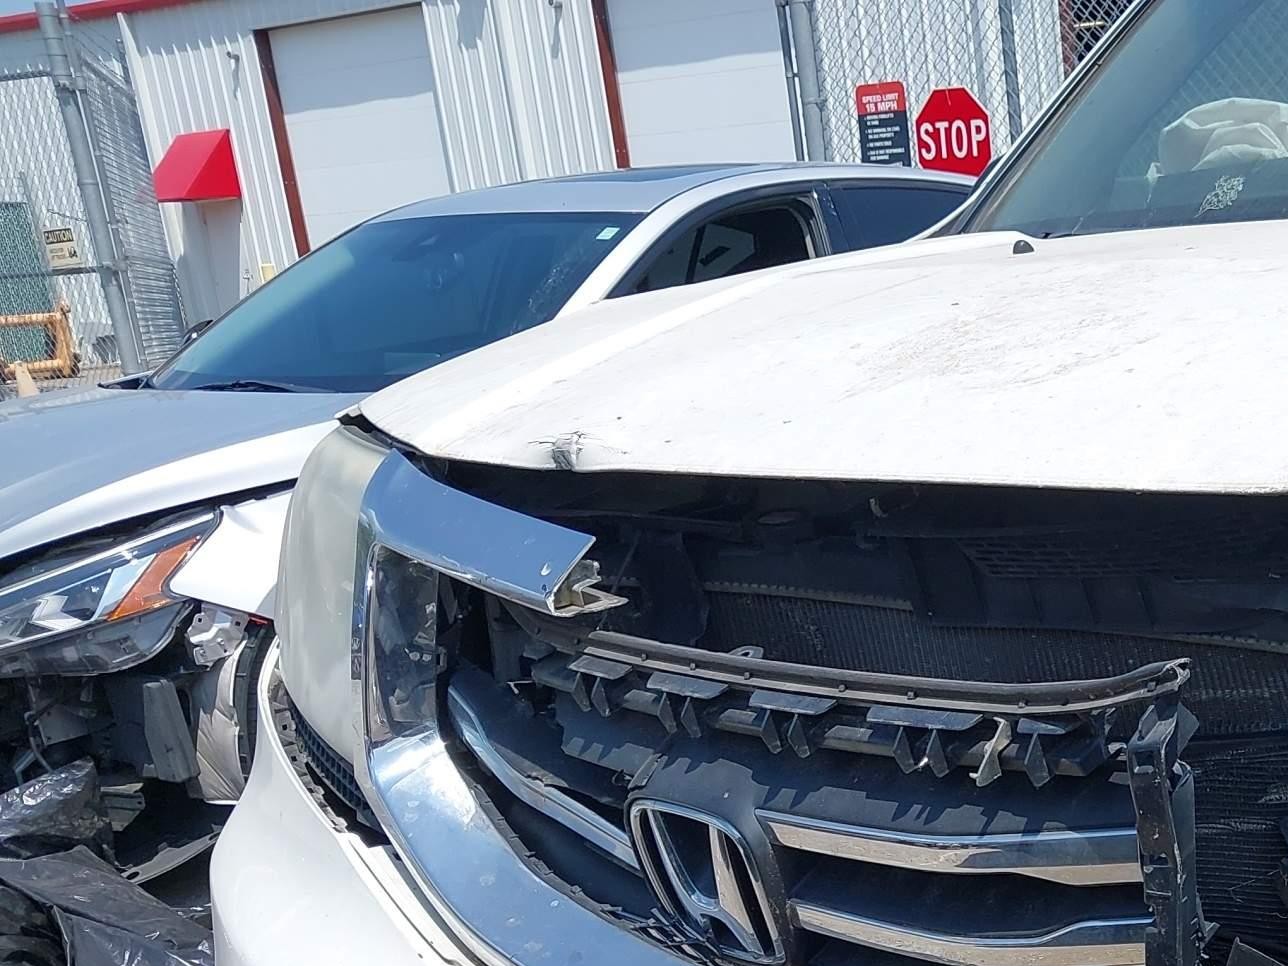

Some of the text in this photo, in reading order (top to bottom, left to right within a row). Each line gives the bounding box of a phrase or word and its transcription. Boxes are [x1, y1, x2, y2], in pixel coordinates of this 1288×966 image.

[877, 101, 898, 112] MPH
[920, 120, 987, 161] STOP
[44, 230, 73, 243] CAUTION
